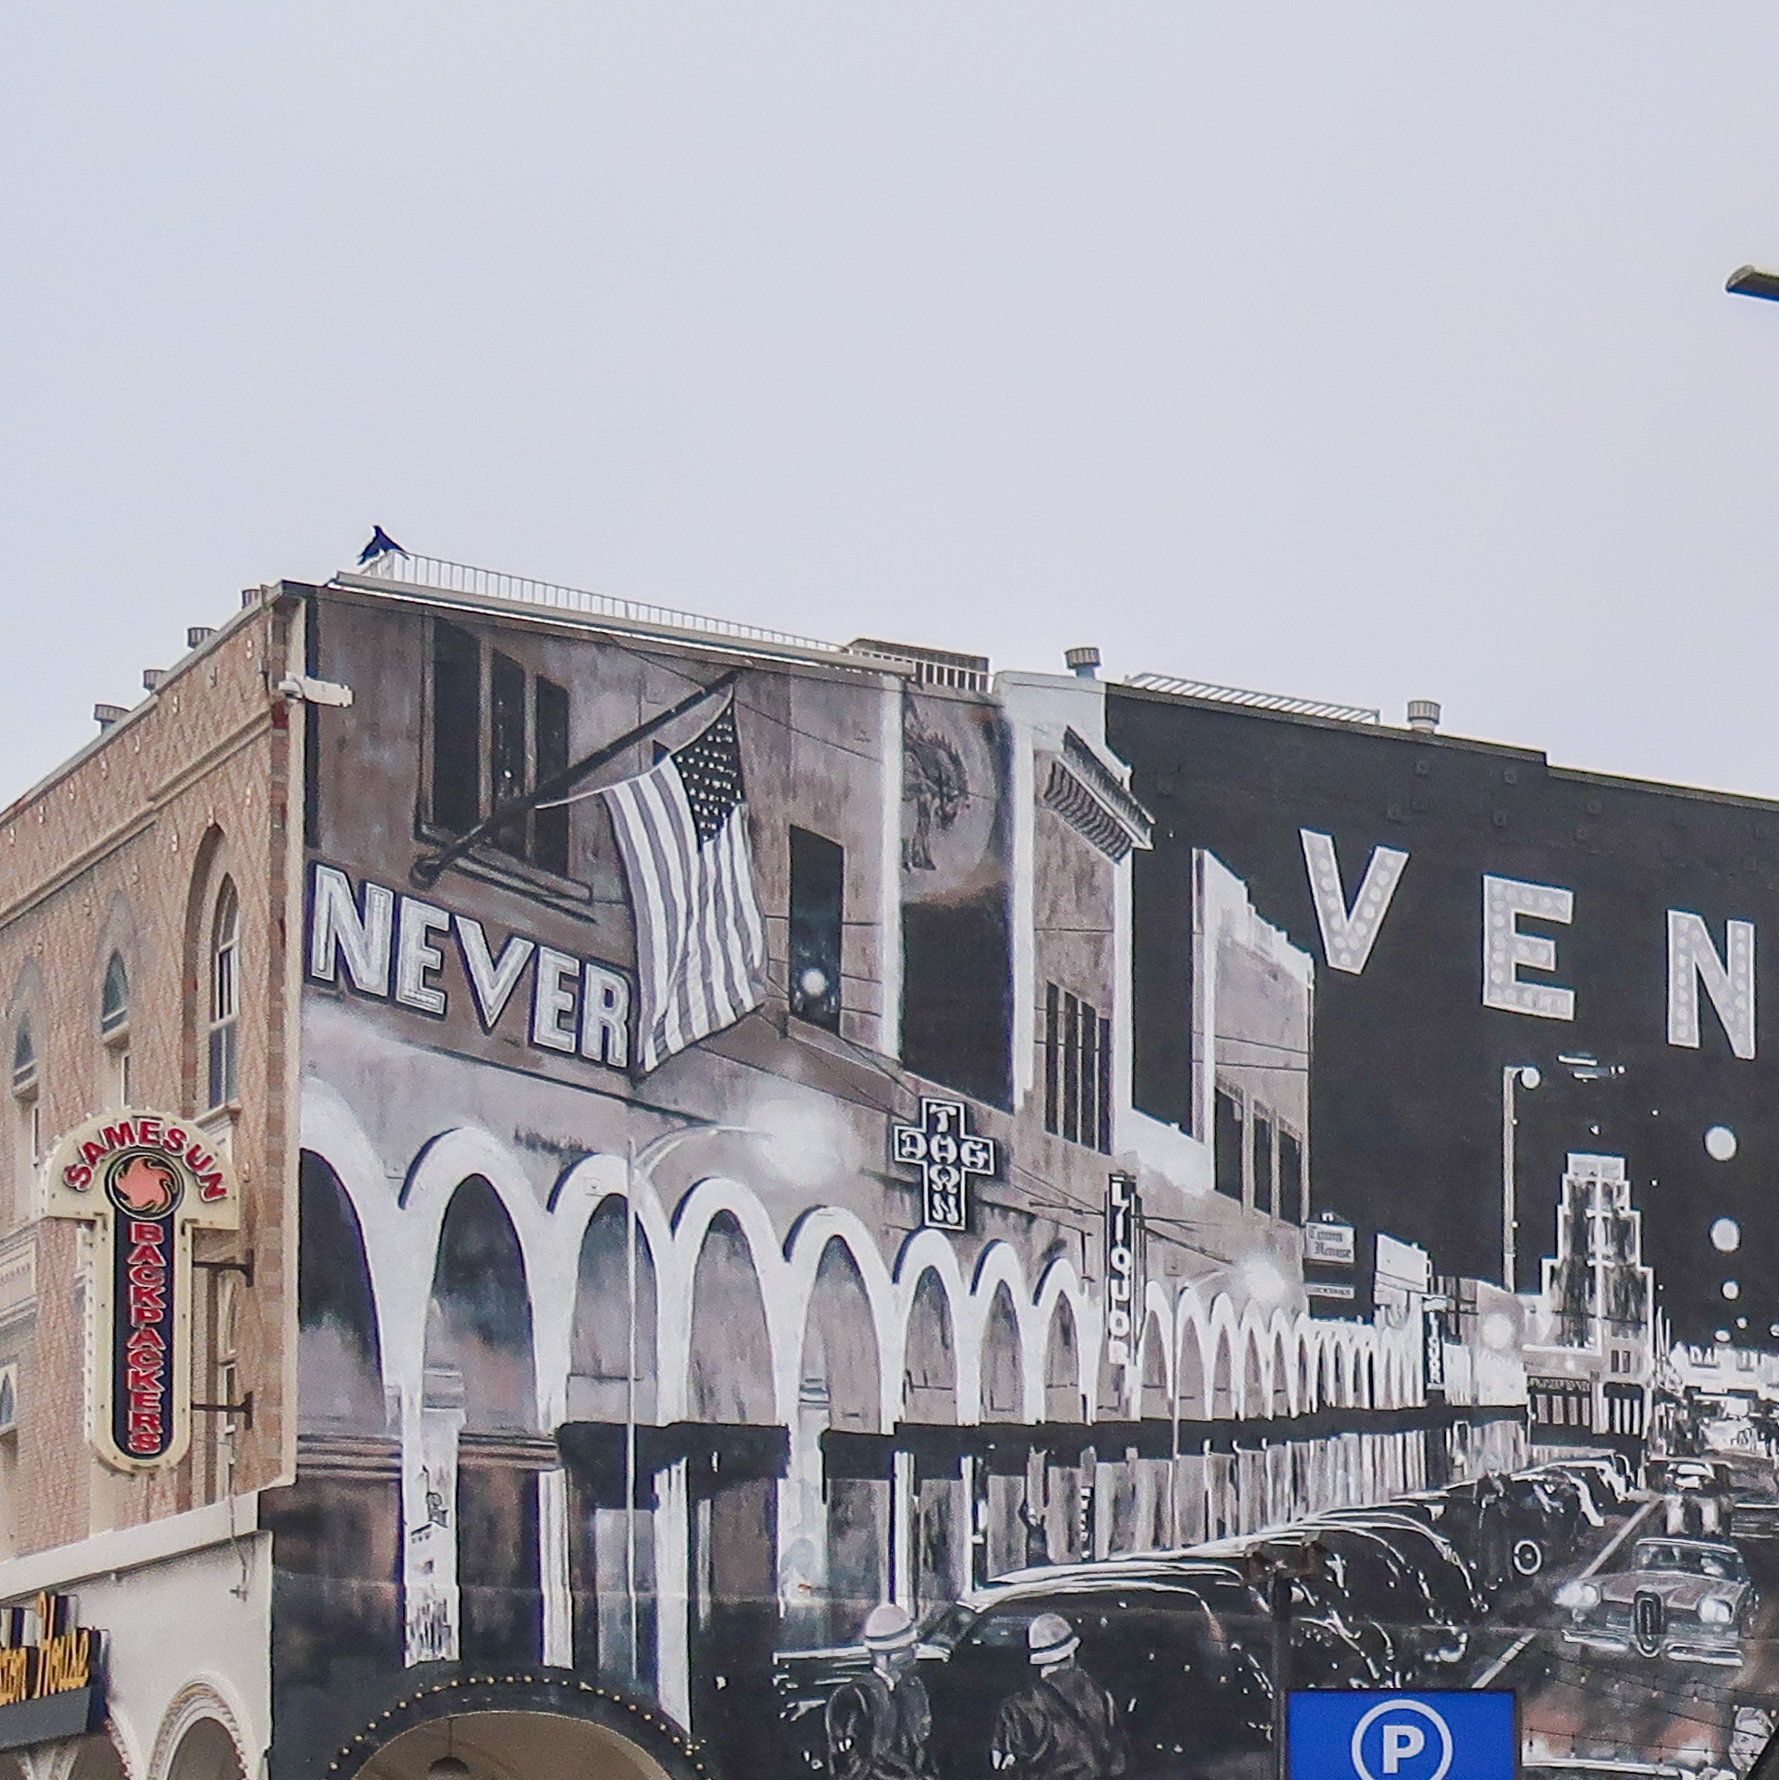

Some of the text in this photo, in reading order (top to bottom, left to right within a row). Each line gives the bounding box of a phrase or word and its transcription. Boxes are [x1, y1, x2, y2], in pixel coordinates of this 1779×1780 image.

[308, 861, 632, 1070] NEVER
[63, 1118, 228, 1201] SAMESUN
[126, 1221, 166, 1454] BACKPACKERS
[1382, 1725, 1425, 1774] P
